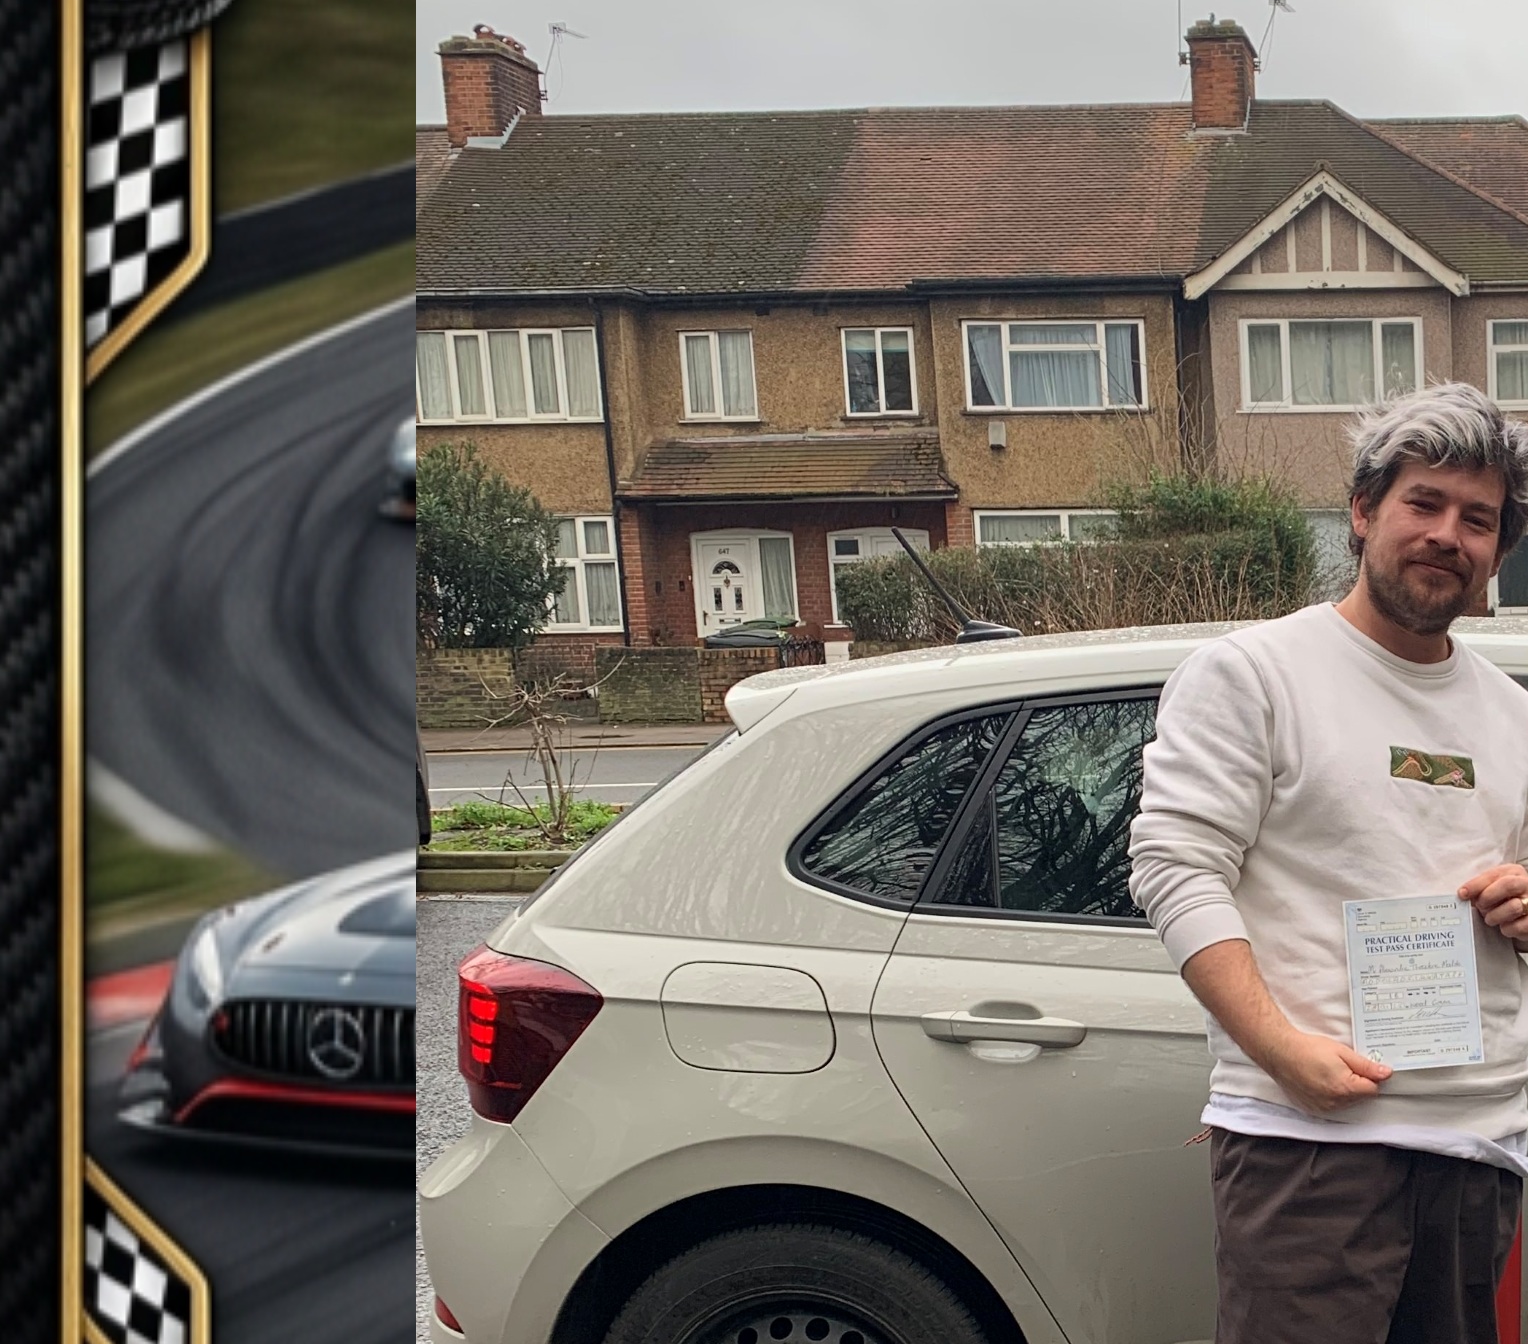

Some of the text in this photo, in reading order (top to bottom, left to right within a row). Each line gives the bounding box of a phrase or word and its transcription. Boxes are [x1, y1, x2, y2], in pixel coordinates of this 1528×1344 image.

[1364, 931, 1455, 946] PRACTICAL DRIVING
[1366, 940, 1455, 954] TEST PASS CERTIFICATE
